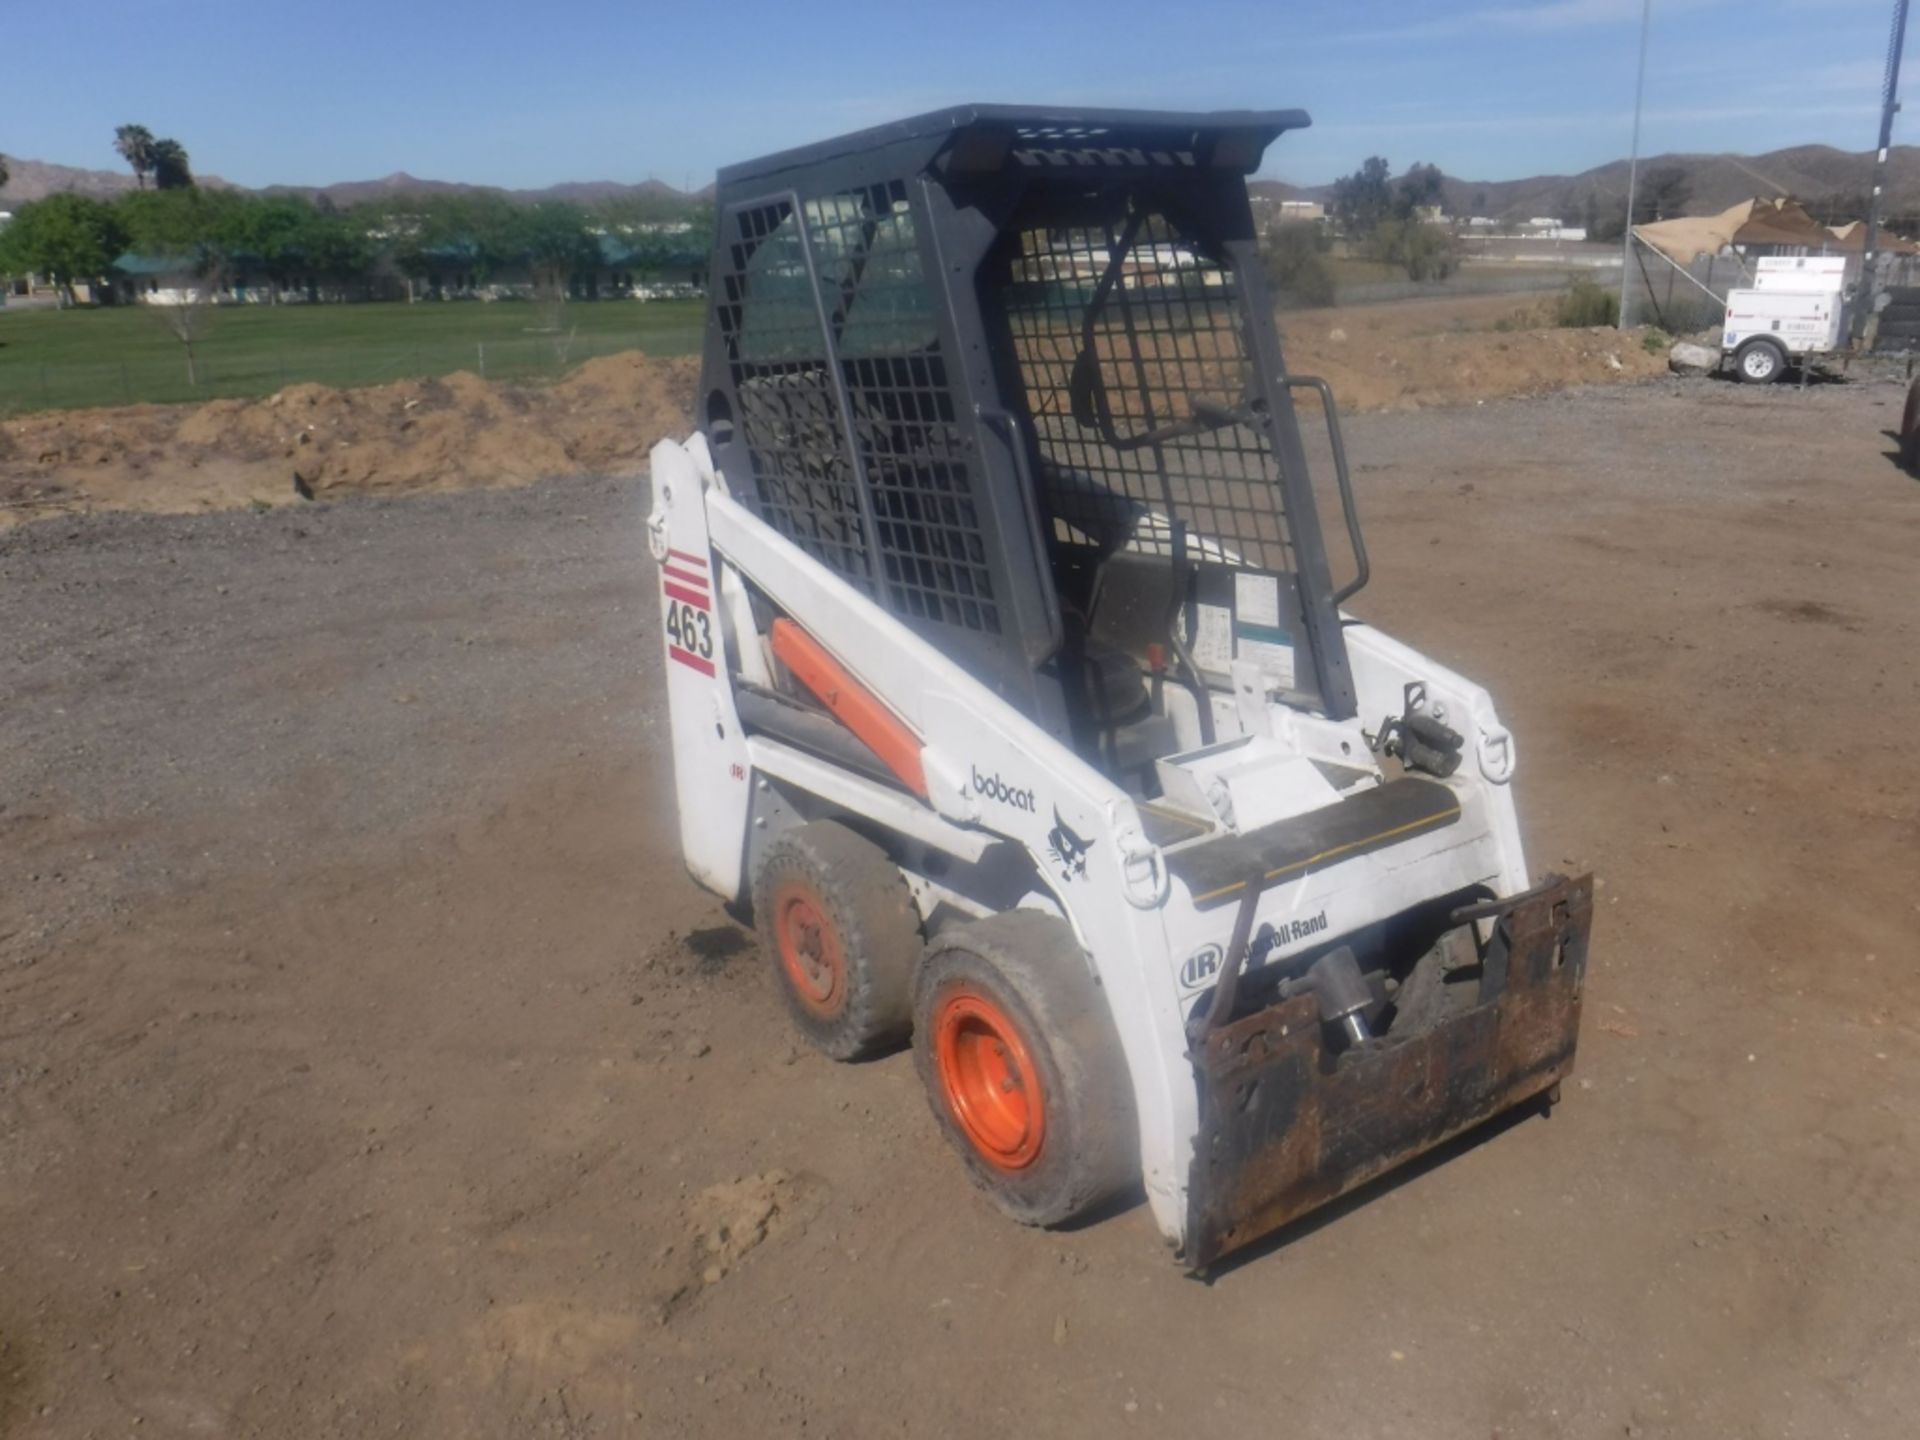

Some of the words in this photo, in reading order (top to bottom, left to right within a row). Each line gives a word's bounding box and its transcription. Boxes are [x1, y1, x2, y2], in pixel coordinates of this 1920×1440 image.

[667, 600, 713, 659] 463
[972, 764, 1036, 813] bobcat
[1187, 949, 1217, 983] IR
